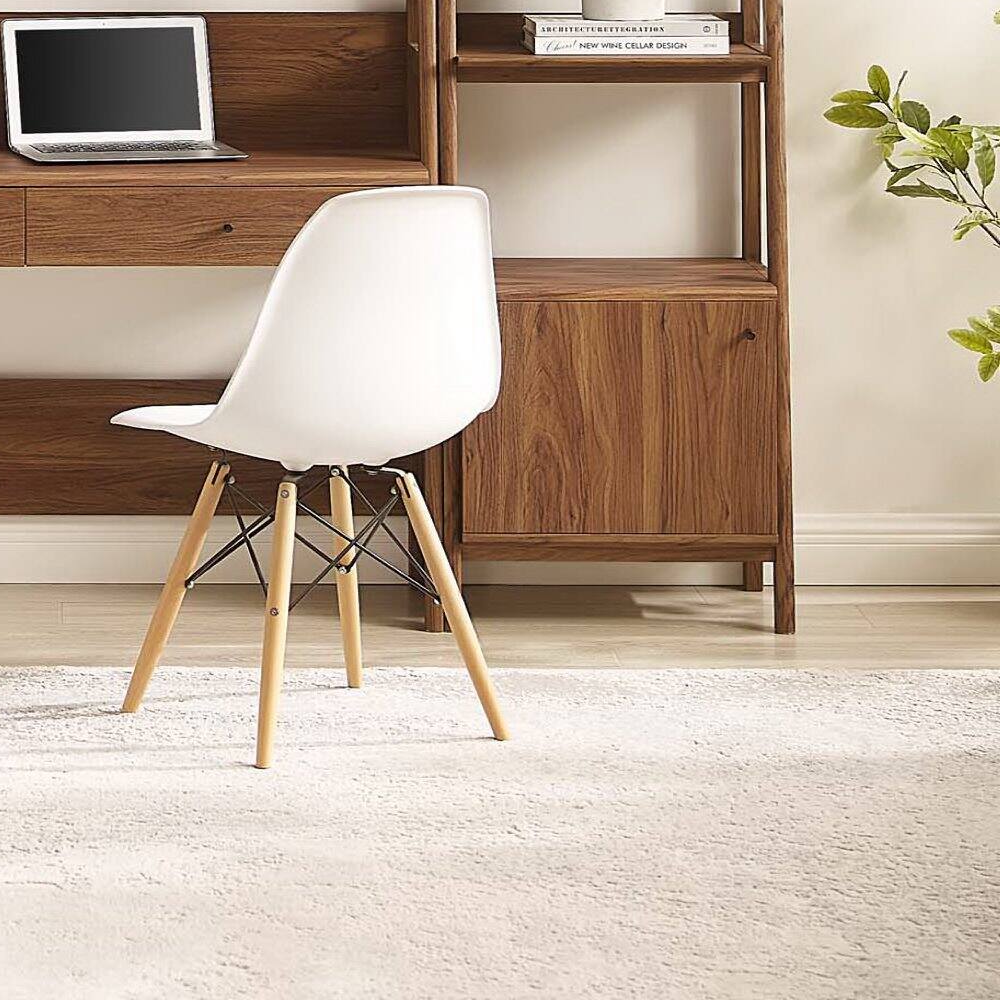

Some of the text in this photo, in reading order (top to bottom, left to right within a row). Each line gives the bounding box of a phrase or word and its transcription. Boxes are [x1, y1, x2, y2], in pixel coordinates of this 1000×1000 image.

[579, 42, 600, 50] NEW
[601, 42, 622, 50] WINE
[624, 42, 654, 50] CELLAR
[655, 42, 688, 50] DESIGN
